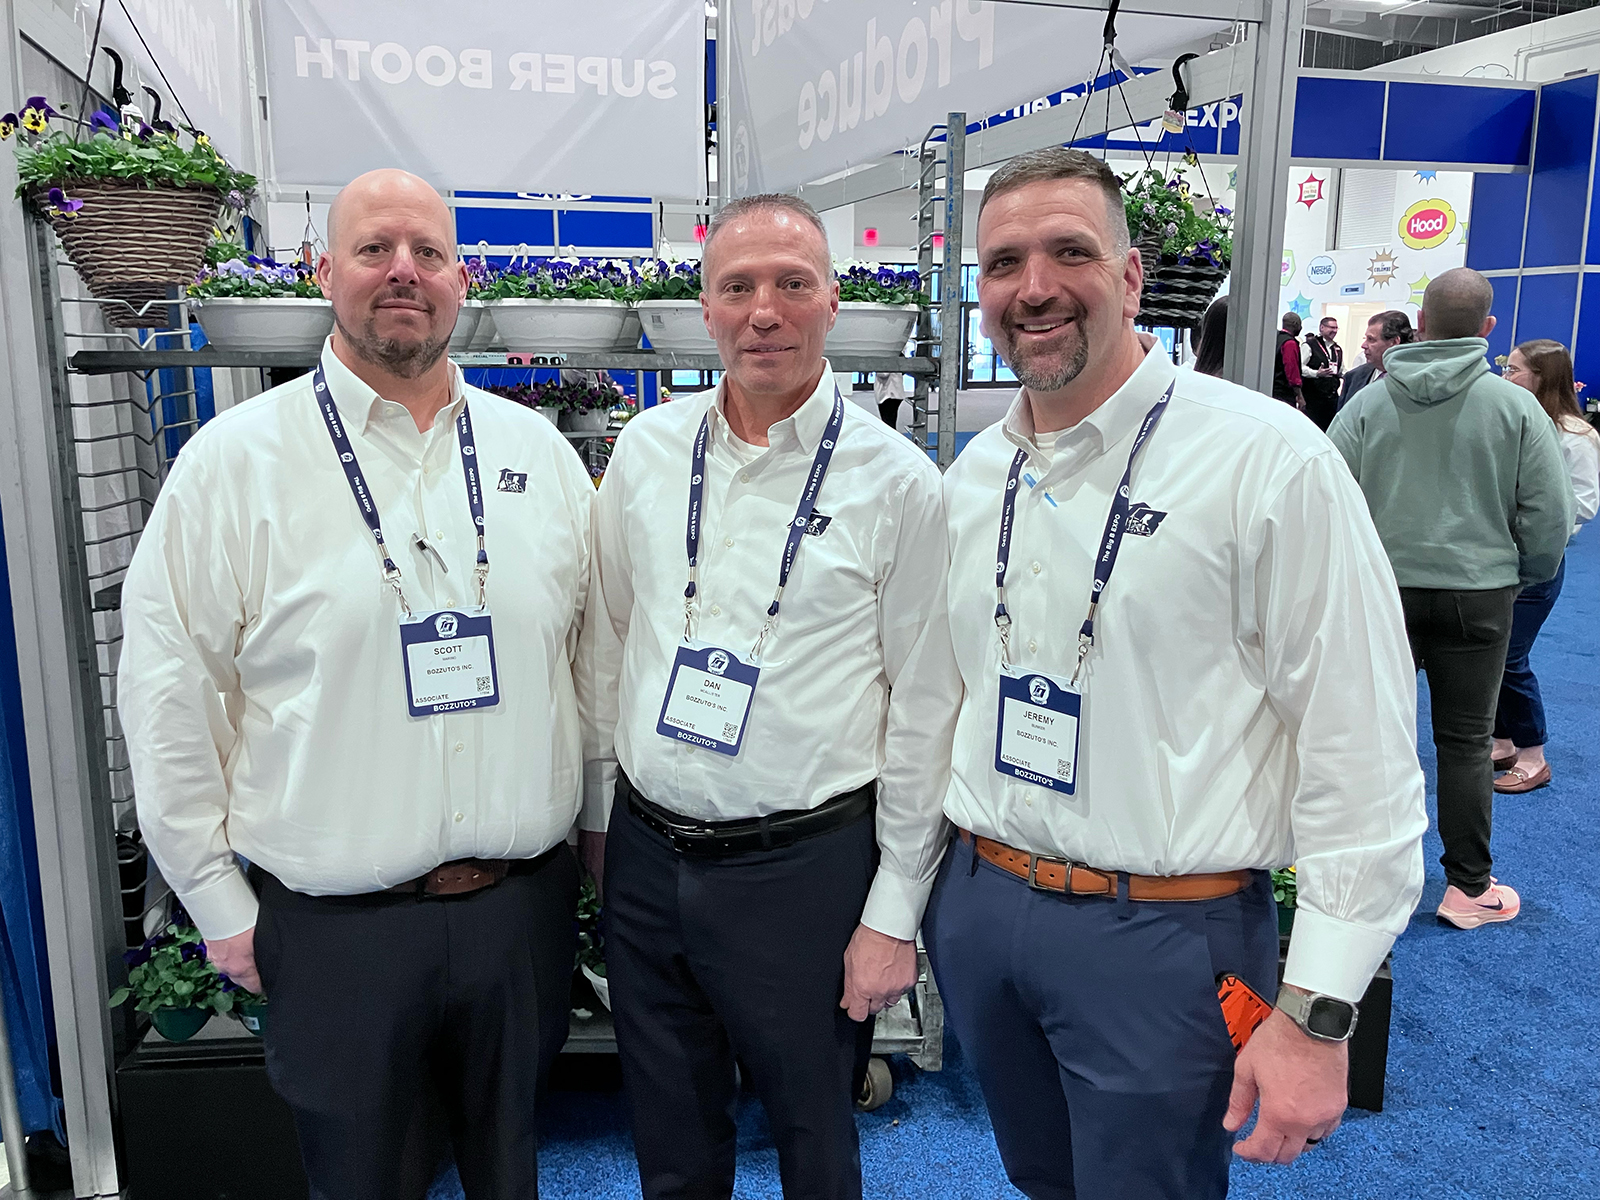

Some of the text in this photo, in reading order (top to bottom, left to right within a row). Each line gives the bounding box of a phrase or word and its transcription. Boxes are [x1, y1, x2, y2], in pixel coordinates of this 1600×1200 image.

[1185, 102, 1243, 128] EXP
[1410, 214, 1444, 233] Hood
[1102, 550, 1110, 562] The
[1106, 538, 1114, 550] Big
[1111, 514, 1121, 532] EXPO
[434, 645, 462, 655] SCOTT
[426, 665, 461, 675] BOZZUTO'S
[703, 679, 721, 690] DAN
[415, 694, 449, 704] ASSOCIATE
[433, 700, 477, 712] BOZZUTO'S
[685, 694, 716, 709] BOZZUTO'S
[665, 715, 696, 730] ASSOCIATE
[1023, 710, 1055, 726] JEREMY
[677, 731, 717, 748] BOZZUTO'S
[1016, 729, 1046, 744] BOZZUTO'S
[1002, 754, 1031, 769] ASSOCIATE
[1014, 768, 1054, 787] BOZZUTO'S
